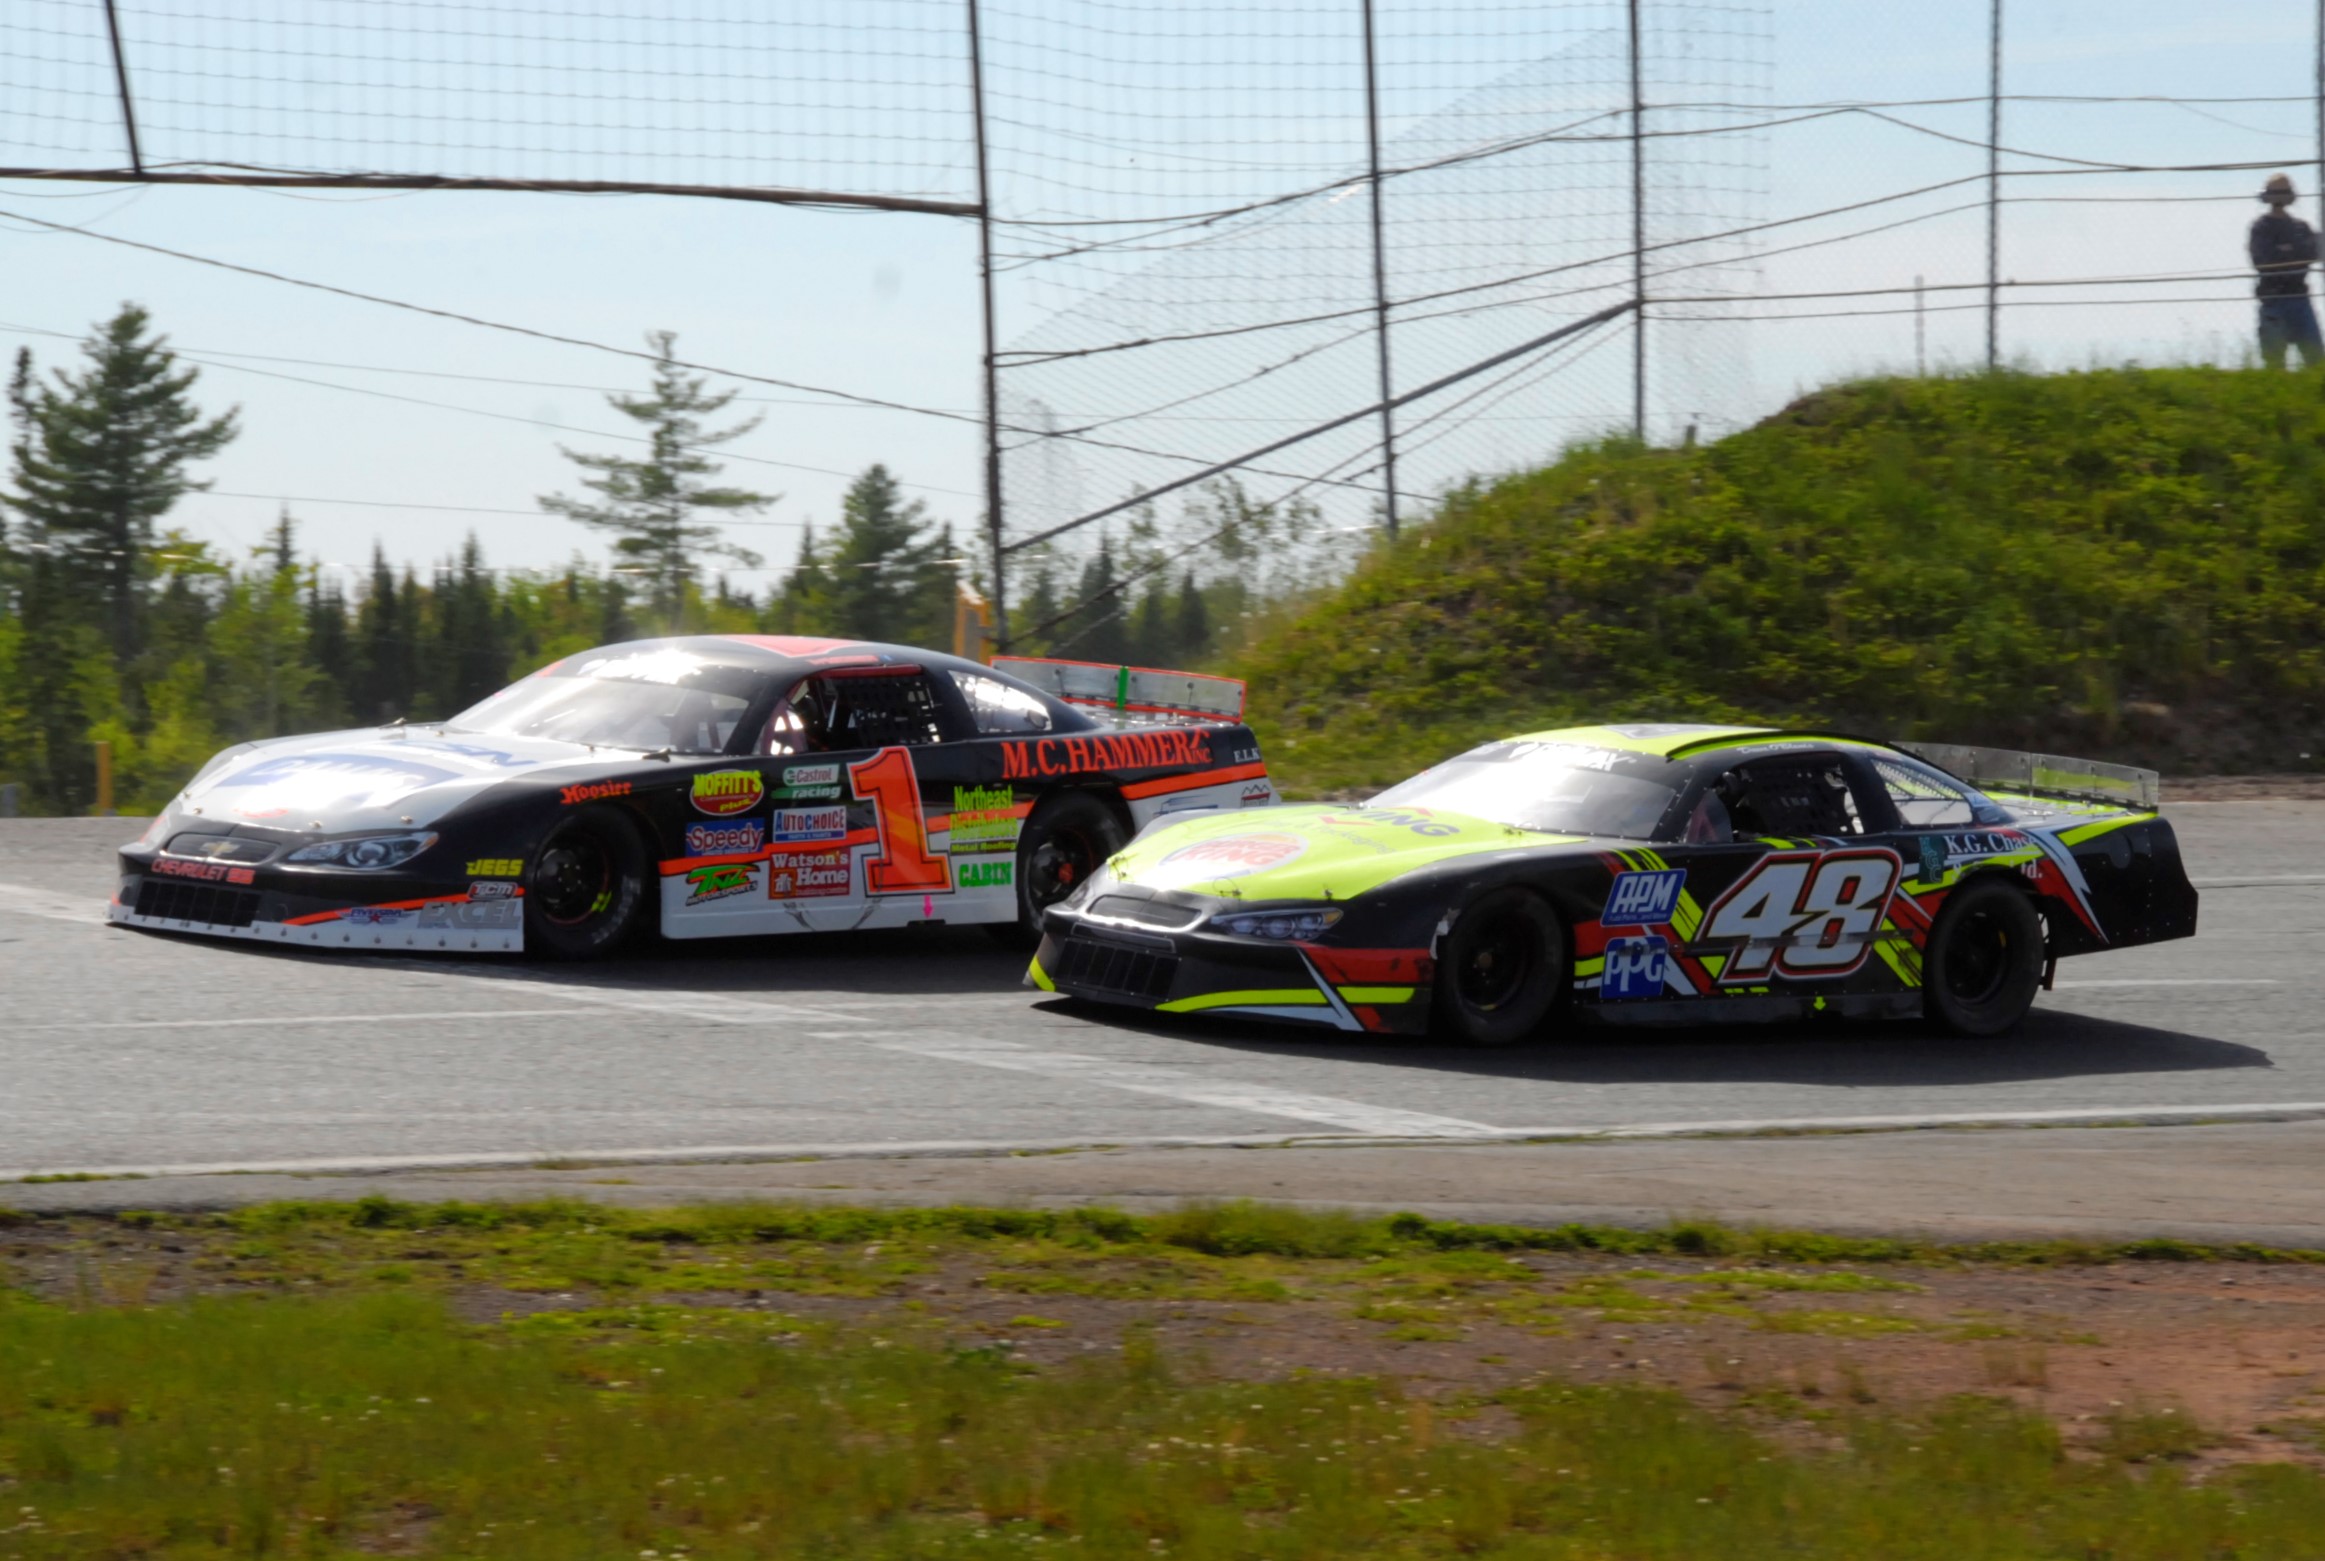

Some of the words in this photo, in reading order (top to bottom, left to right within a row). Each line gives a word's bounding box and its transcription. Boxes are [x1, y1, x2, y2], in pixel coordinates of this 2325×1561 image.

[694, 770, 763, 797] MOFFITT'S
[796, 767, 832, 783] Castrol
[559, 780, 633, 804] Hoosier
[791, 785, 842, 799] racing
[953, 784, 1014, 812] Northeast
[848, 746, 954, 897] 1
[687, 823, 764, 852] Speedy
[151, 858, 228, 881] CHEVROLET
[466, 859, 524, 876] JEGS
[771, 852, 849, 868] Watson's
[796, 866, 849, 886] Home
[958, 861, 1013, 889] CABIN
[417, 901, 522, 930] EXCEL
[1702, 849, 1901, 981] 48
[1604, 936, 1668, 993] PPG
